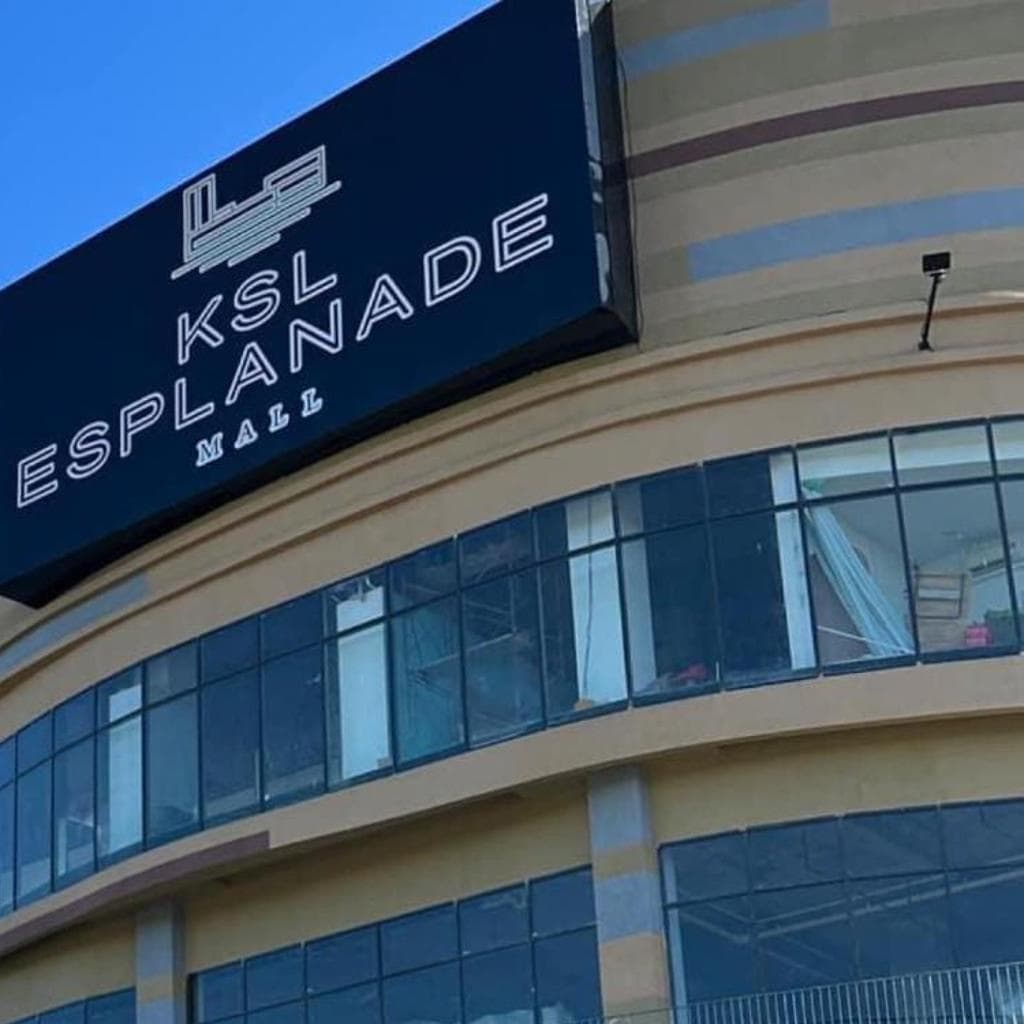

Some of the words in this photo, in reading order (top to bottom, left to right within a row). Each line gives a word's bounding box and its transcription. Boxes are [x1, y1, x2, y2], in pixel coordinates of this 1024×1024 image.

[16, 193, 554, 508] ESPLANADE
[177, 250, 338, 365] KSL
[196, 387, 323, 467] MALL
